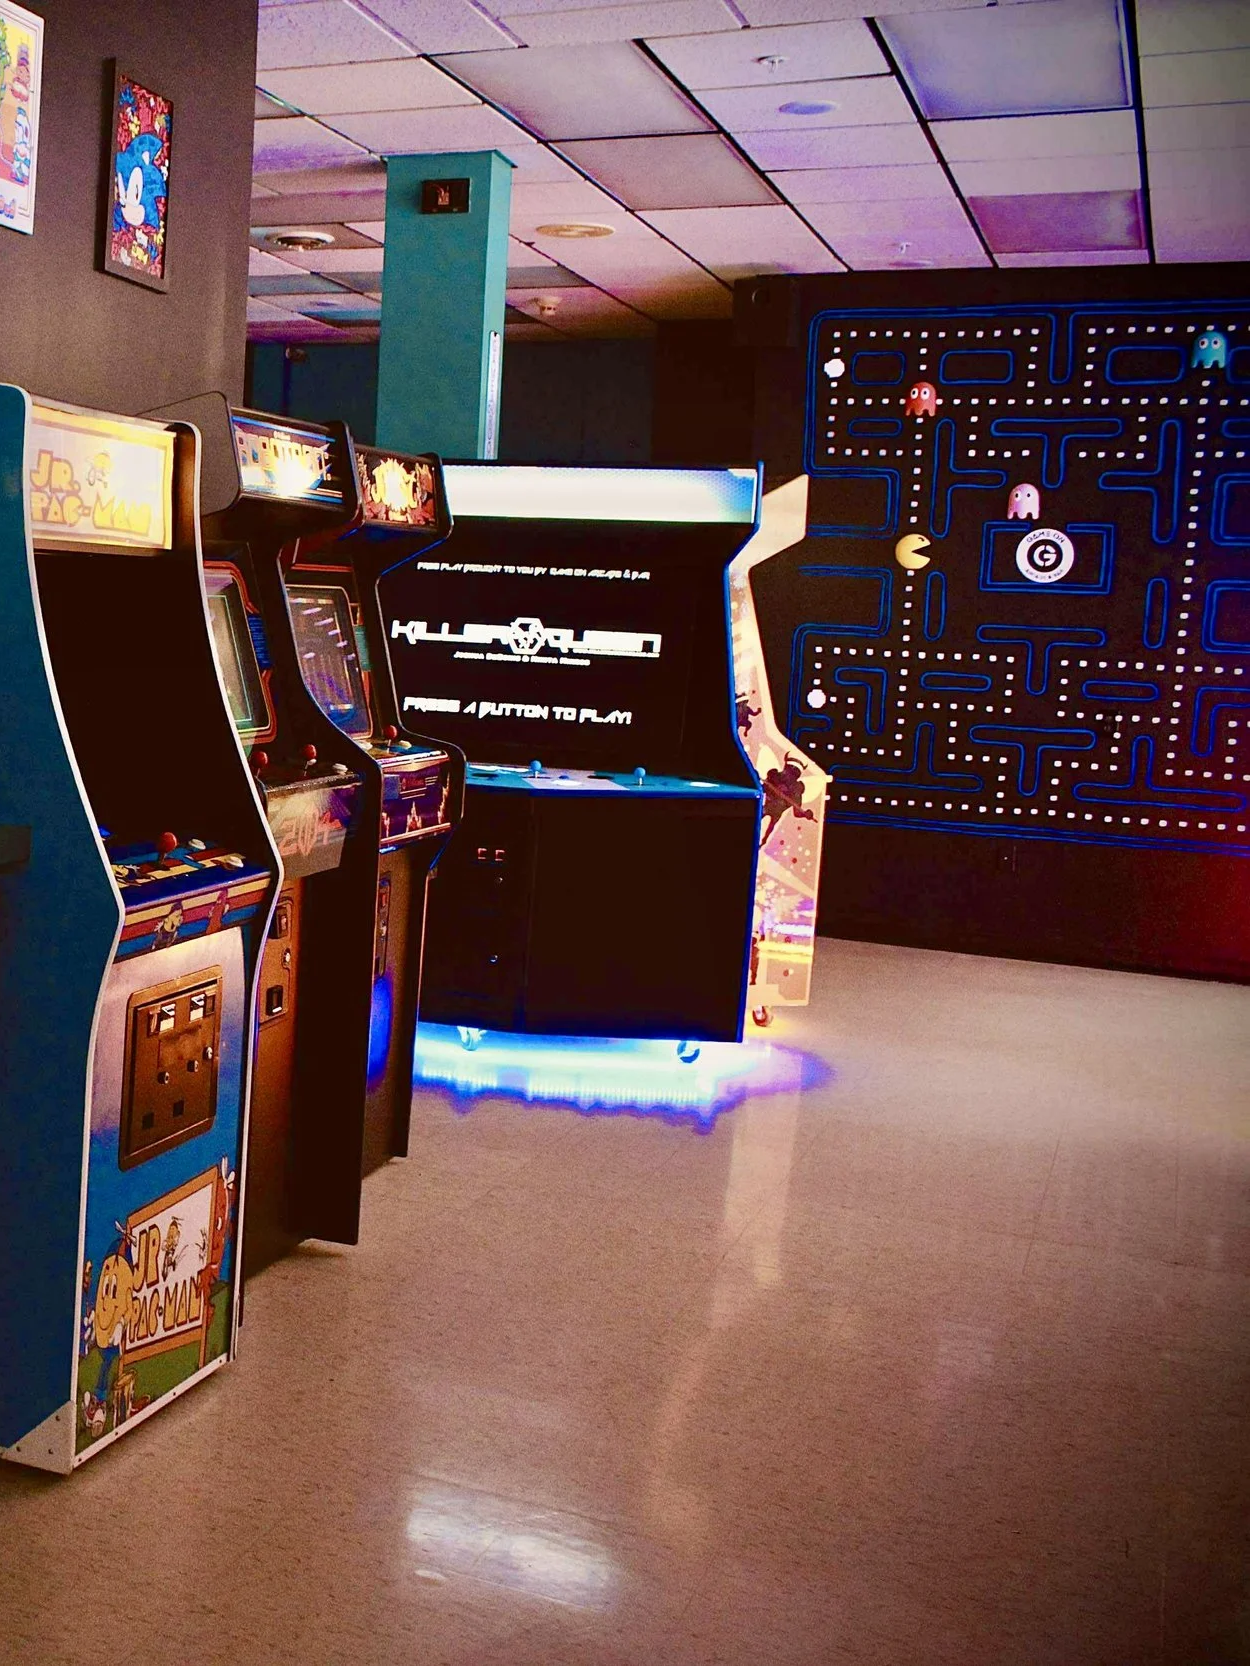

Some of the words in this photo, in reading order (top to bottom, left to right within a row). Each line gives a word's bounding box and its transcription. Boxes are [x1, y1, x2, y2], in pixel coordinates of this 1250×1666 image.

[30, 449, 81, 494] JR.
[30, 490, 150, 537] PAC-MAN
[440, 562, 464, 572] PLAY
[503, 565, 516, 574] TO
[623, 569, 631, 579] &
[1033, 545, 1057, 567] G
[463, 701, 477, 714] A
[478, 701, 549, 720] BUTTON
[552, 706, 577, 721] TO
[579, 708, 633, 725] PLAY!
[132, 1223, 161, 1293] JR
